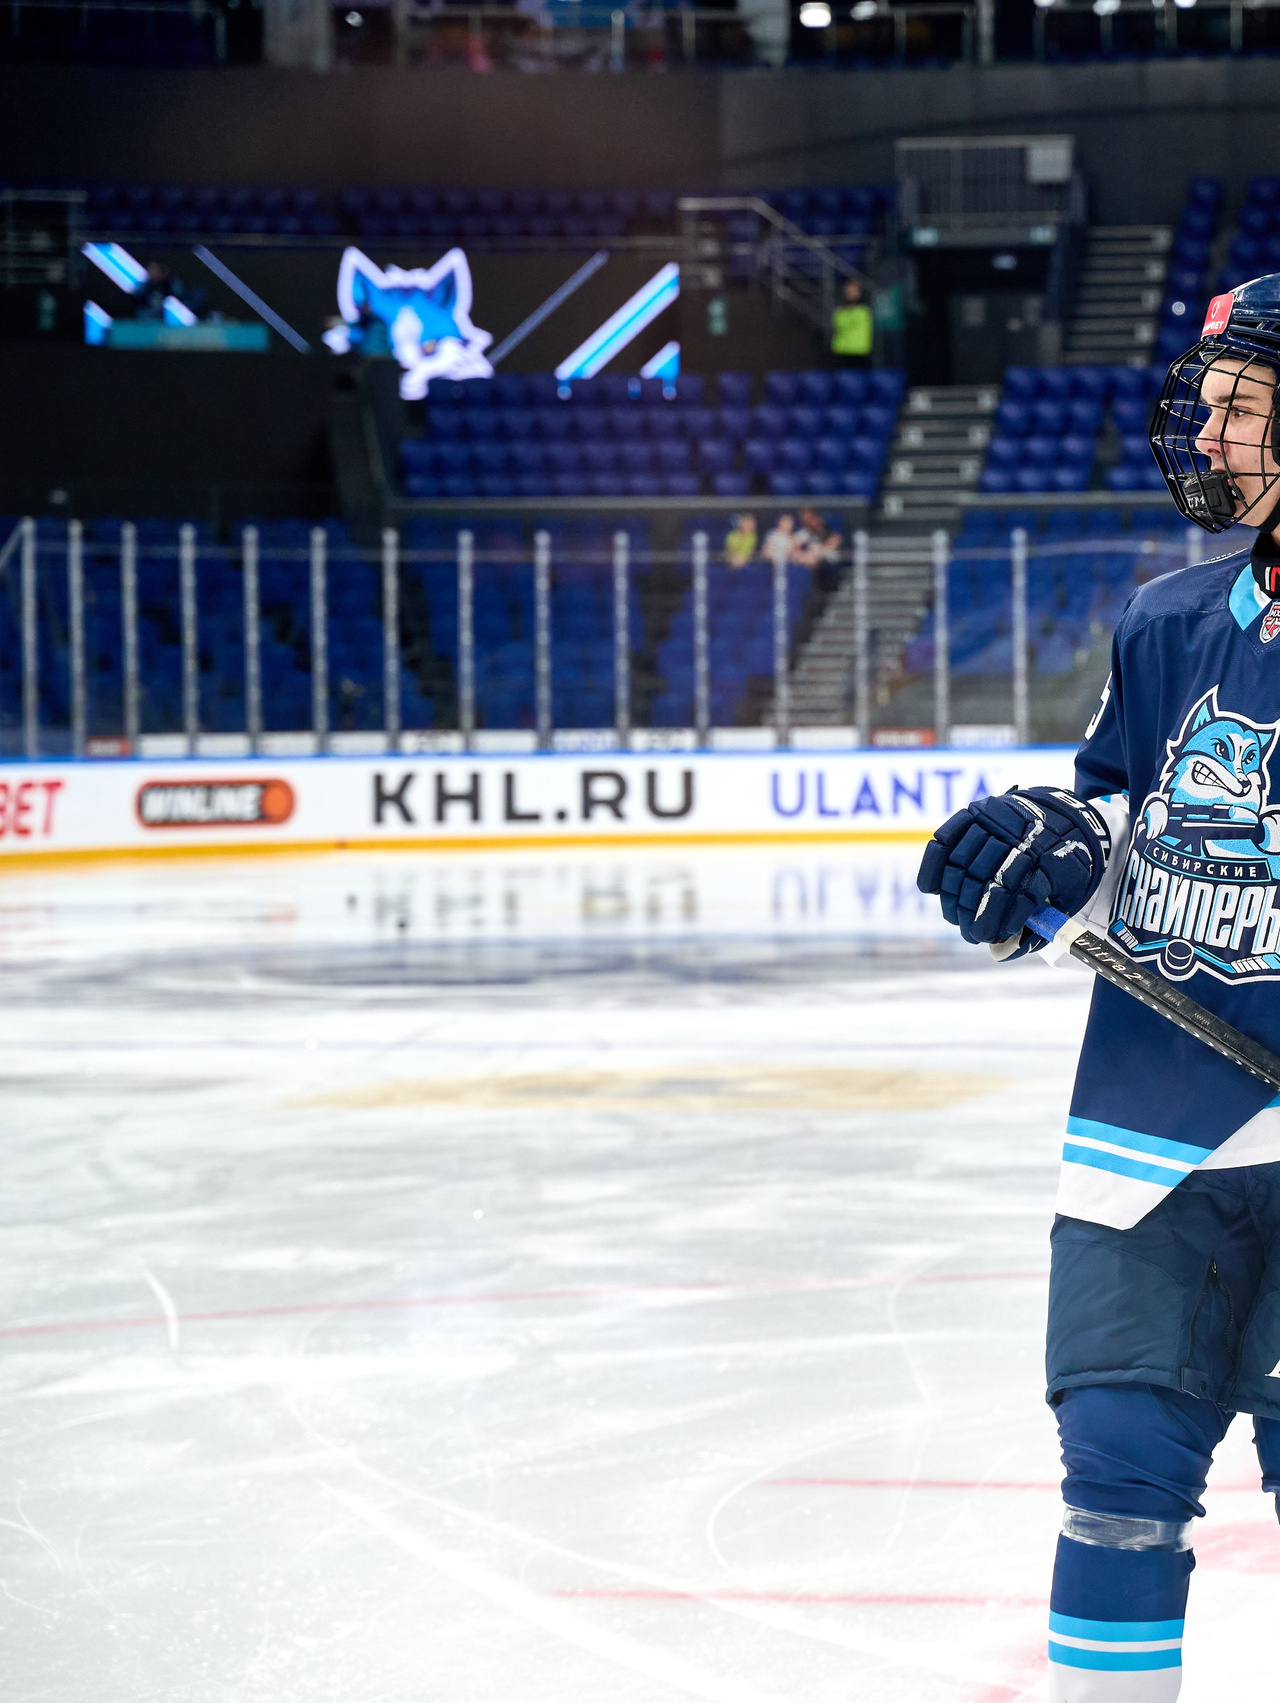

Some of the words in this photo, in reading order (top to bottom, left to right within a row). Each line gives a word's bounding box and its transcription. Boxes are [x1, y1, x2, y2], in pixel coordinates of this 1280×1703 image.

[371, 770, 695, 826] KHL.RU
[770, 769, 990, 818] ULANTA
[1152, 846, 1258, 878] СИБИРСКИЕ
